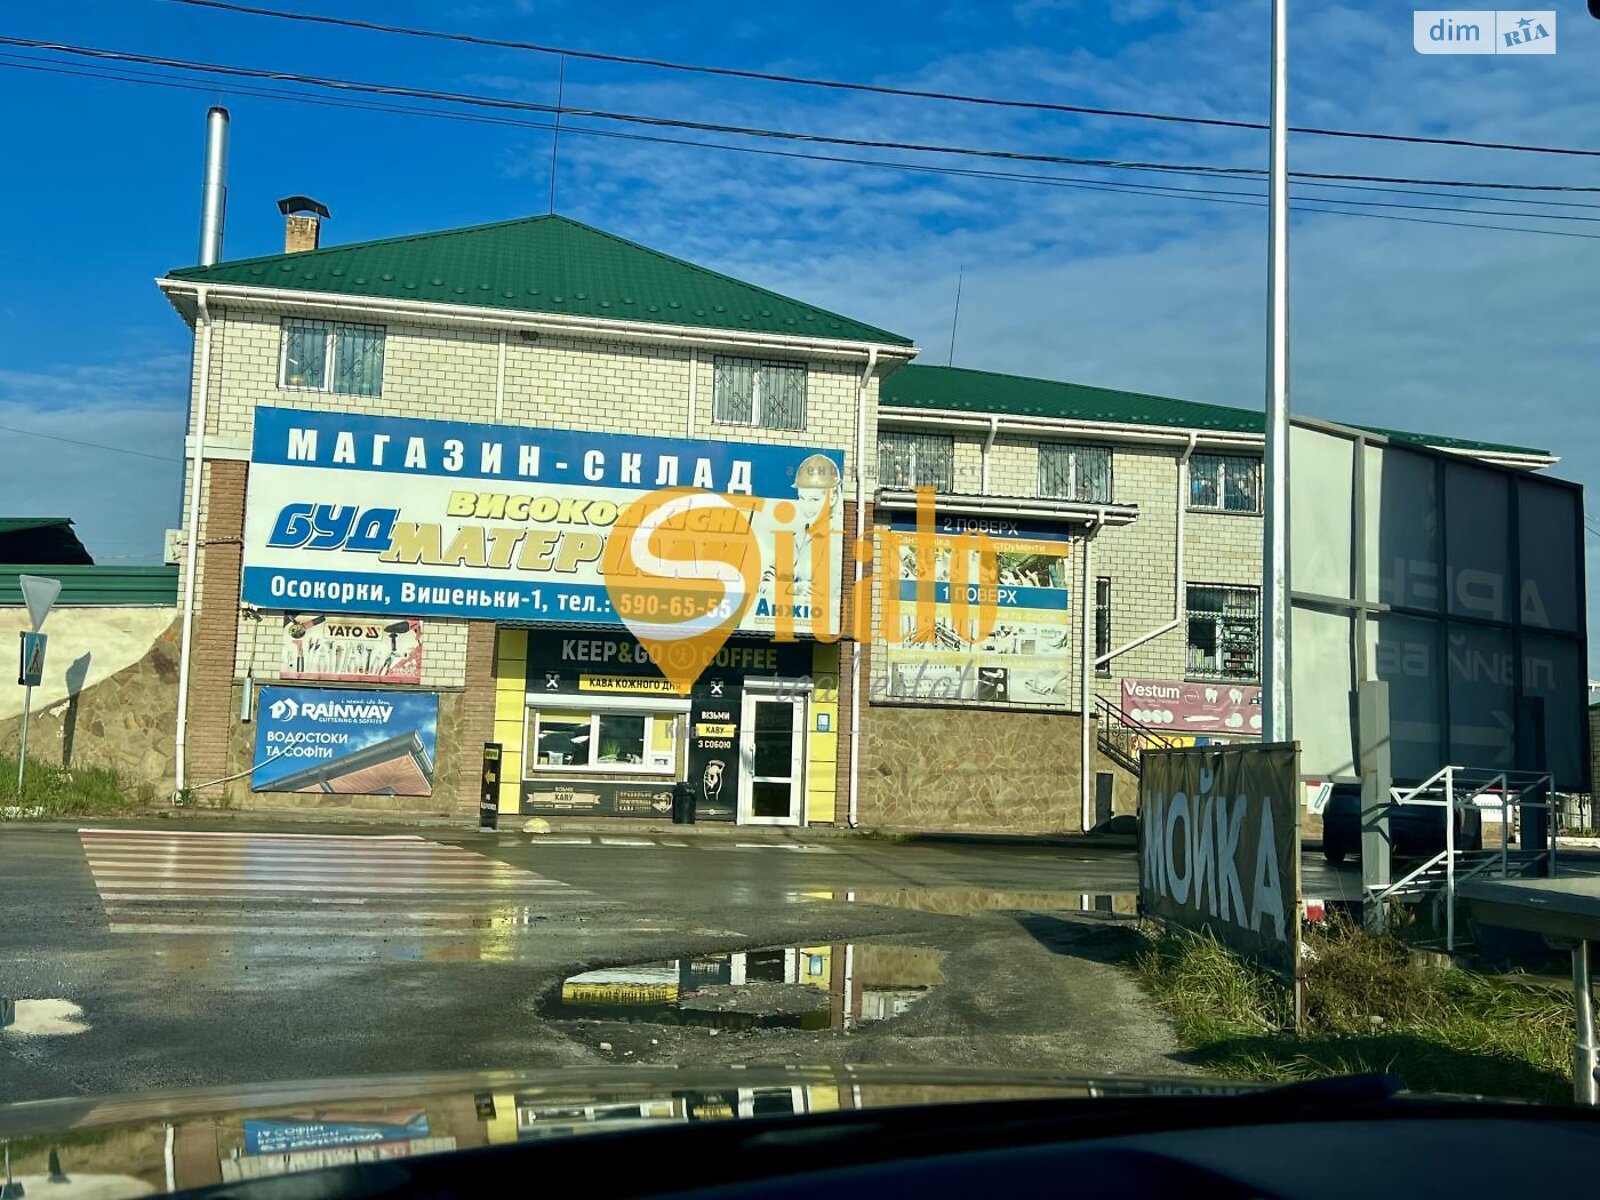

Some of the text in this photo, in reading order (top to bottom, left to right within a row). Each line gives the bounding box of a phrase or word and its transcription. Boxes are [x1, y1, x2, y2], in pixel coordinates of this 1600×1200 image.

[943, 518, 1019, 536] 2 ПОВЕРХ
[270, 575, 733, 619] Осокорки, Вишеньки-1, тел.: 590-65-55
[942, 587, 1018, 604] 1 ПОВЕРХ
[327, 624, 363, 638] YATO
[562, 639, 778, 669] KEEP&GO COFFEE
[589, 677, 614, 688] КАВА
[615, 679, 661, 690] КОЖНОГО
[1124, 681, 1180, 699] Vestum
[701, 711, 730, 720] ВІЗЬМИ
[267, 731, 349, 744] ВОДОСТОКИ
[705, 727, 725, 735] КАВУ
[266, 745, 333, 758] ТА СОФІТИ
[704, 740, 731, 749] СОБОЮ
[1143, 768, 1288, 942] МОЙКА
